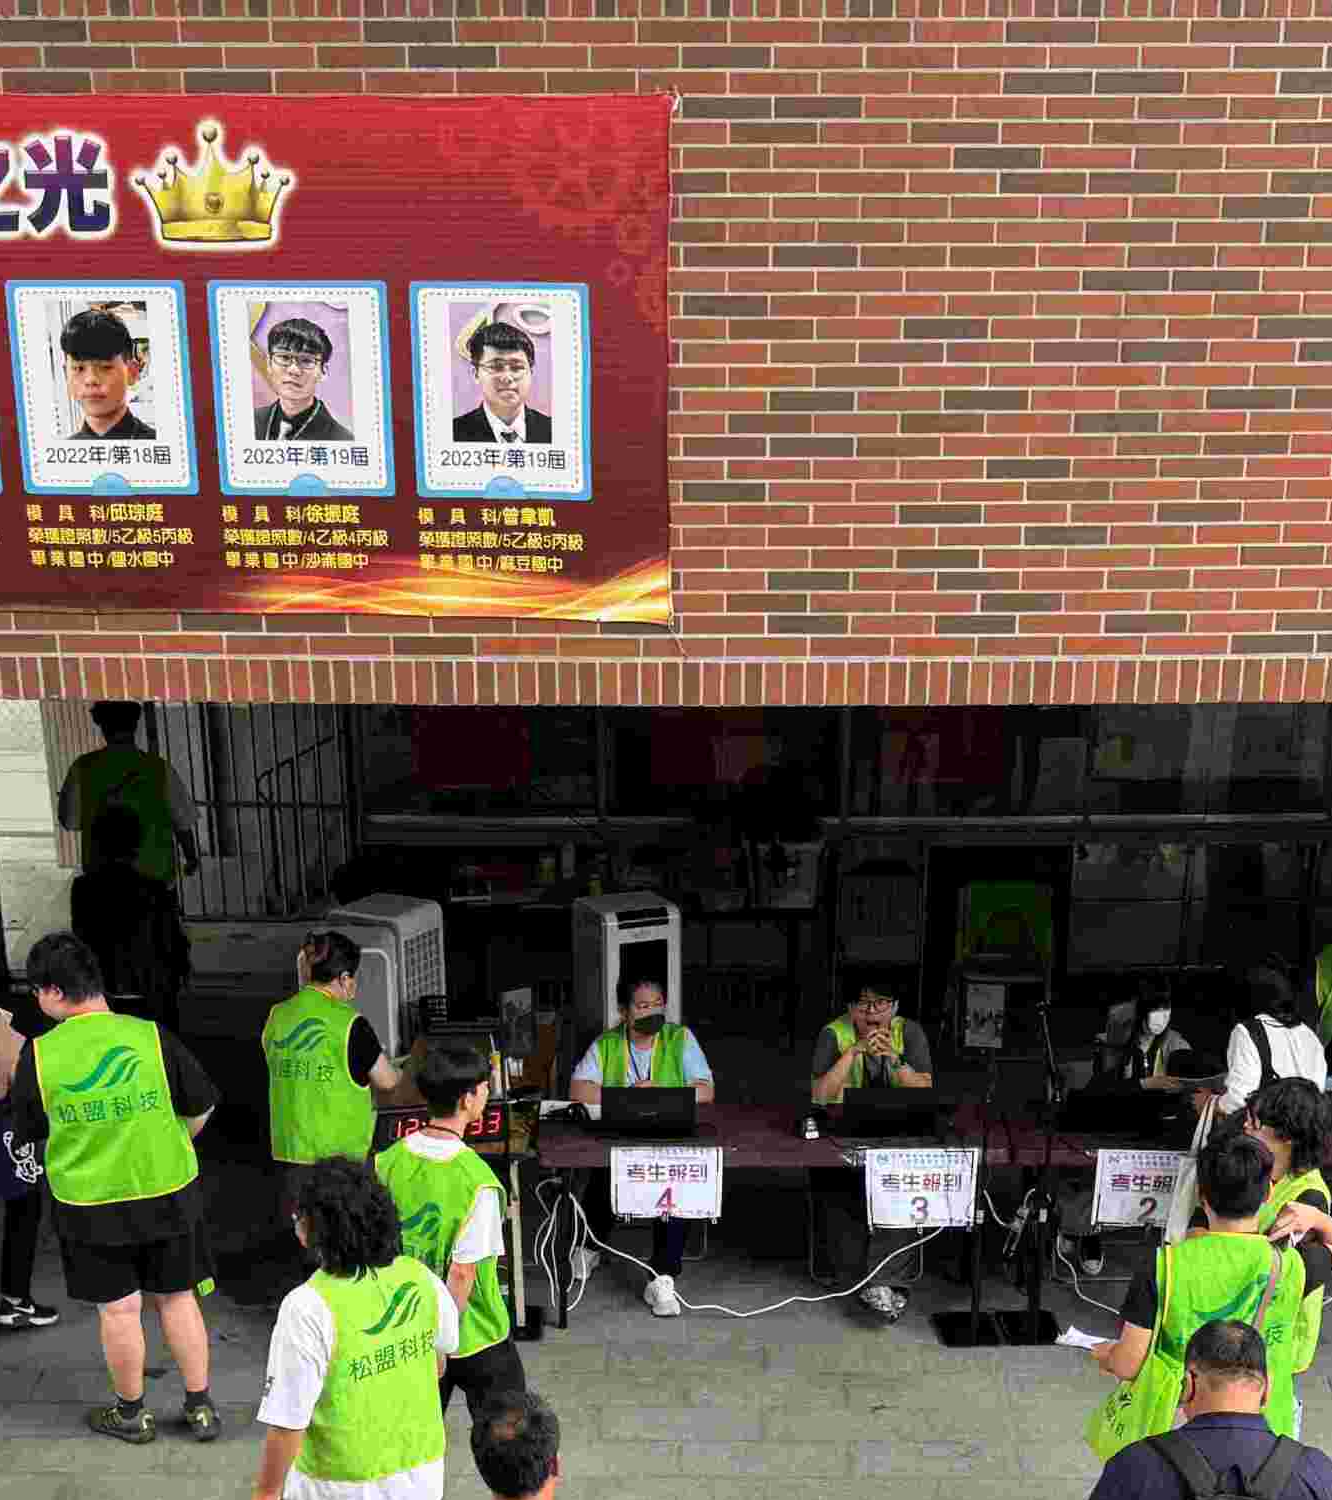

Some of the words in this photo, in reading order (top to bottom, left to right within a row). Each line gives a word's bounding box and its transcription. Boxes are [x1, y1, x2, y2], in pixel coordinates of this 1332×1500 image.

[45, 445, 171, 466] 2022年/第18屆
[242, 446, 369, 467] 2023年/第19屆
[440, 448, 566, 470] 2023年/第19屆
[626, 1163, 708, 1184] 考生報到
[880, 1172, 963, 1193] 考生報到
[654, 1186, 676, 1214] 4
[910, 1196, 930, 1224] 3
[1136, 1196, 1158, 1222] 2
